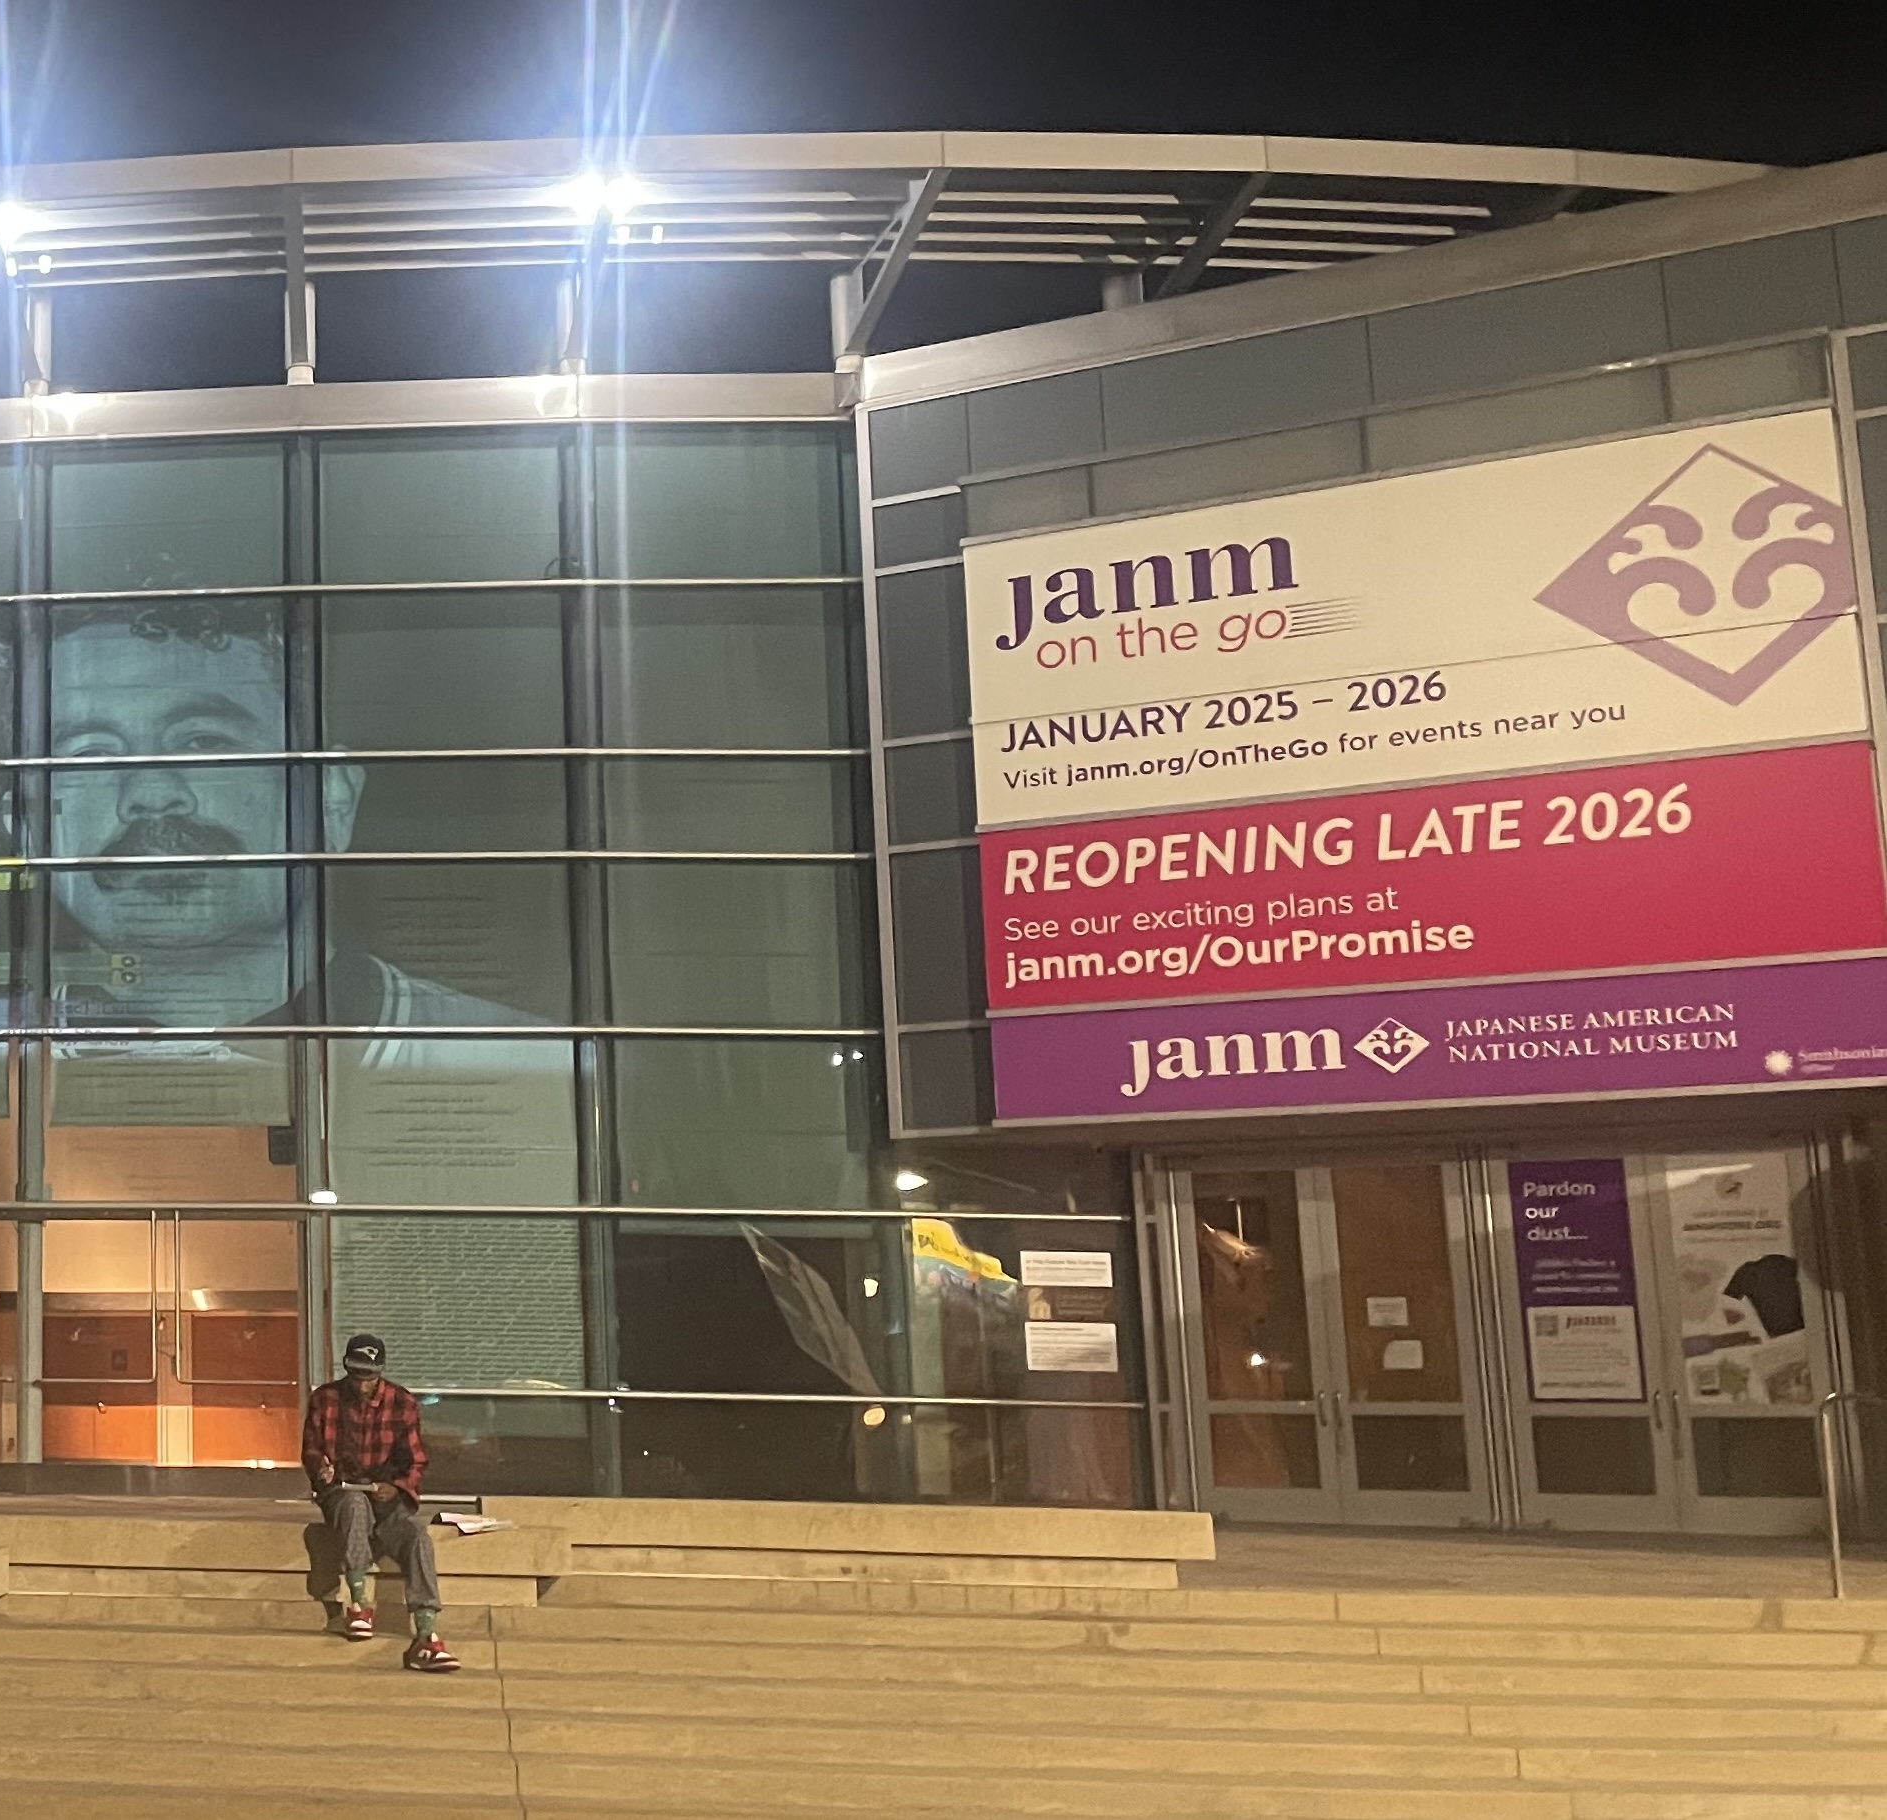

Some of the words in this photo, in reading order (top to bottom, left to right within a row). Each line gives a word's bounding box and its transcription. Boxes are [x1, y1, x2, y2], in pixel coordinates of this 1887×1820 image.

[996, 536, 1299, 651] janm
[1036, 635, 1098, 669] on
[1116, 617, 1198, 659] the
[1217, 609, 1287, 653] go
[1001, 702, 1192, 753] JANUARY
[1203, 690, 1298, 729] 2025
[1347, 670, 1447, 712] 2026
[1003, 765, 1058, 790] Visit
[1066, 737, 1328, 785] janm.org/OnTheGo
[1339, 732, 1379, 754] for
[1388, 718, 1483, 748] events
[1493, 711, 1560, 735] near
[1569, 704, 1626, 730] you
[1003, 816, 1354, 896] REOPENING
[1377, 799, 1524, 863] LATE
[1543, 782, 1693, 847] 2026
[1003, 916, 1060, 942] See
[1069, 913, 1122, 937] our
[1132, 900, 1255, 934] exciting
[1266, 892, 1354, 926] plans
[1365, 886, 1399, 912] at
[1004, 920, 1475, 989] janm.org/OurPromise
[1120, 1024, 1348, 1097] janm
[1444, 1012, 1576, 1042] JAPANESE
[1582, 1003, 1736, 1031] AMERICAN
[1448, 1038, 1600, 1063] NATIONAL
[1608, 1030, 1739, 1054] MUSEUM
[1522, 1181, 1596, 1198] Pardon
[1525, 1206, 1560, 1219] our
